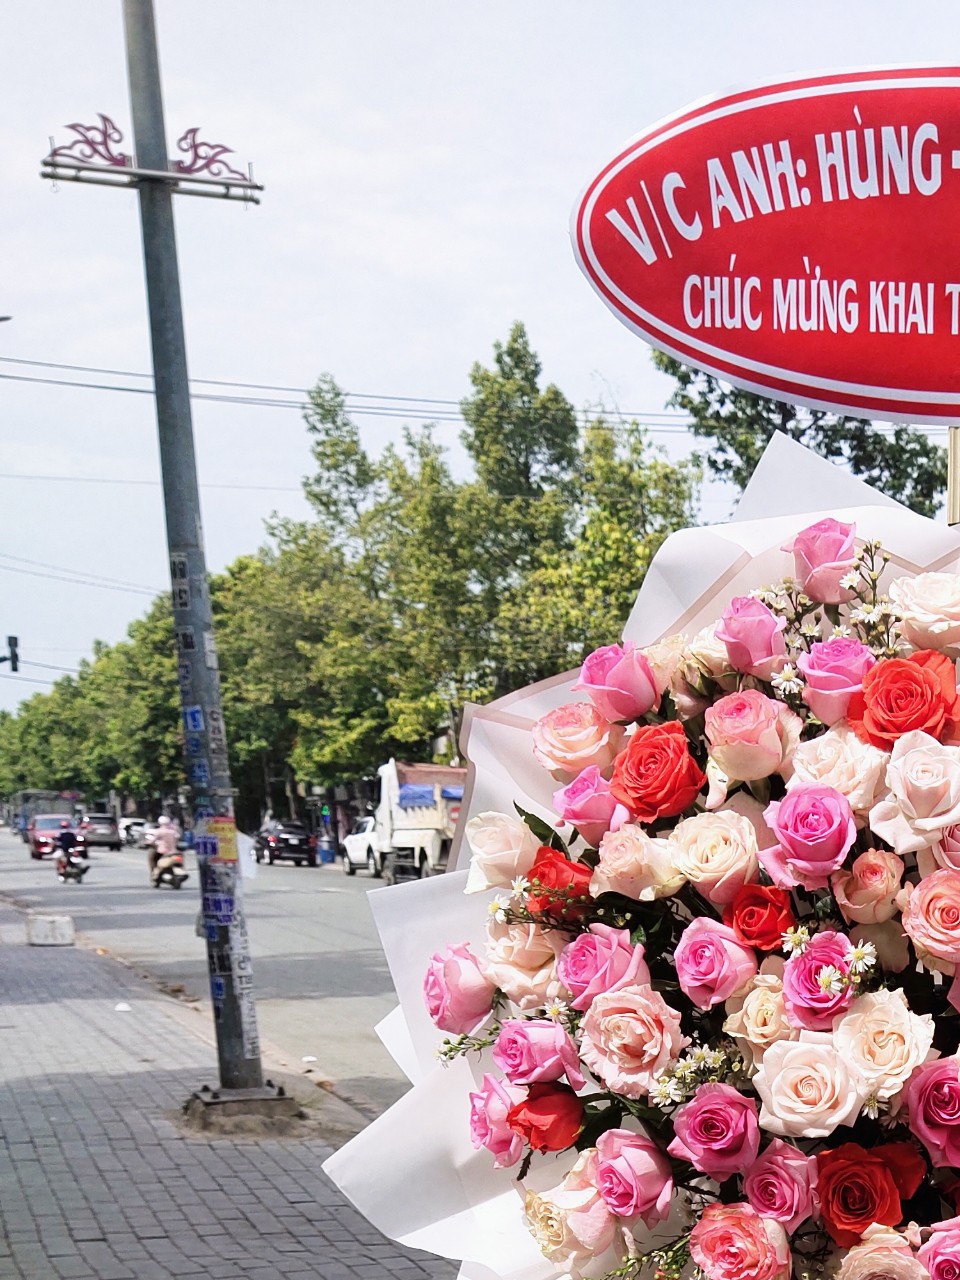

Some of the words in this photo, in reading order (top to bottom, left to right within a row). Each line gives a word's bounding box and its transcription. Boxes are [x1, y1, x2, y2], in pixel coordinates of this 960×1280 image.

[706, 139, 812, 229] ANH:
[814, 104, 942, 203] HÙNG
[683, 253, 762, 331] CHÚC
[772, 256, 859, 334] MỪNG
[869, 281, 935, 334] KHAI
